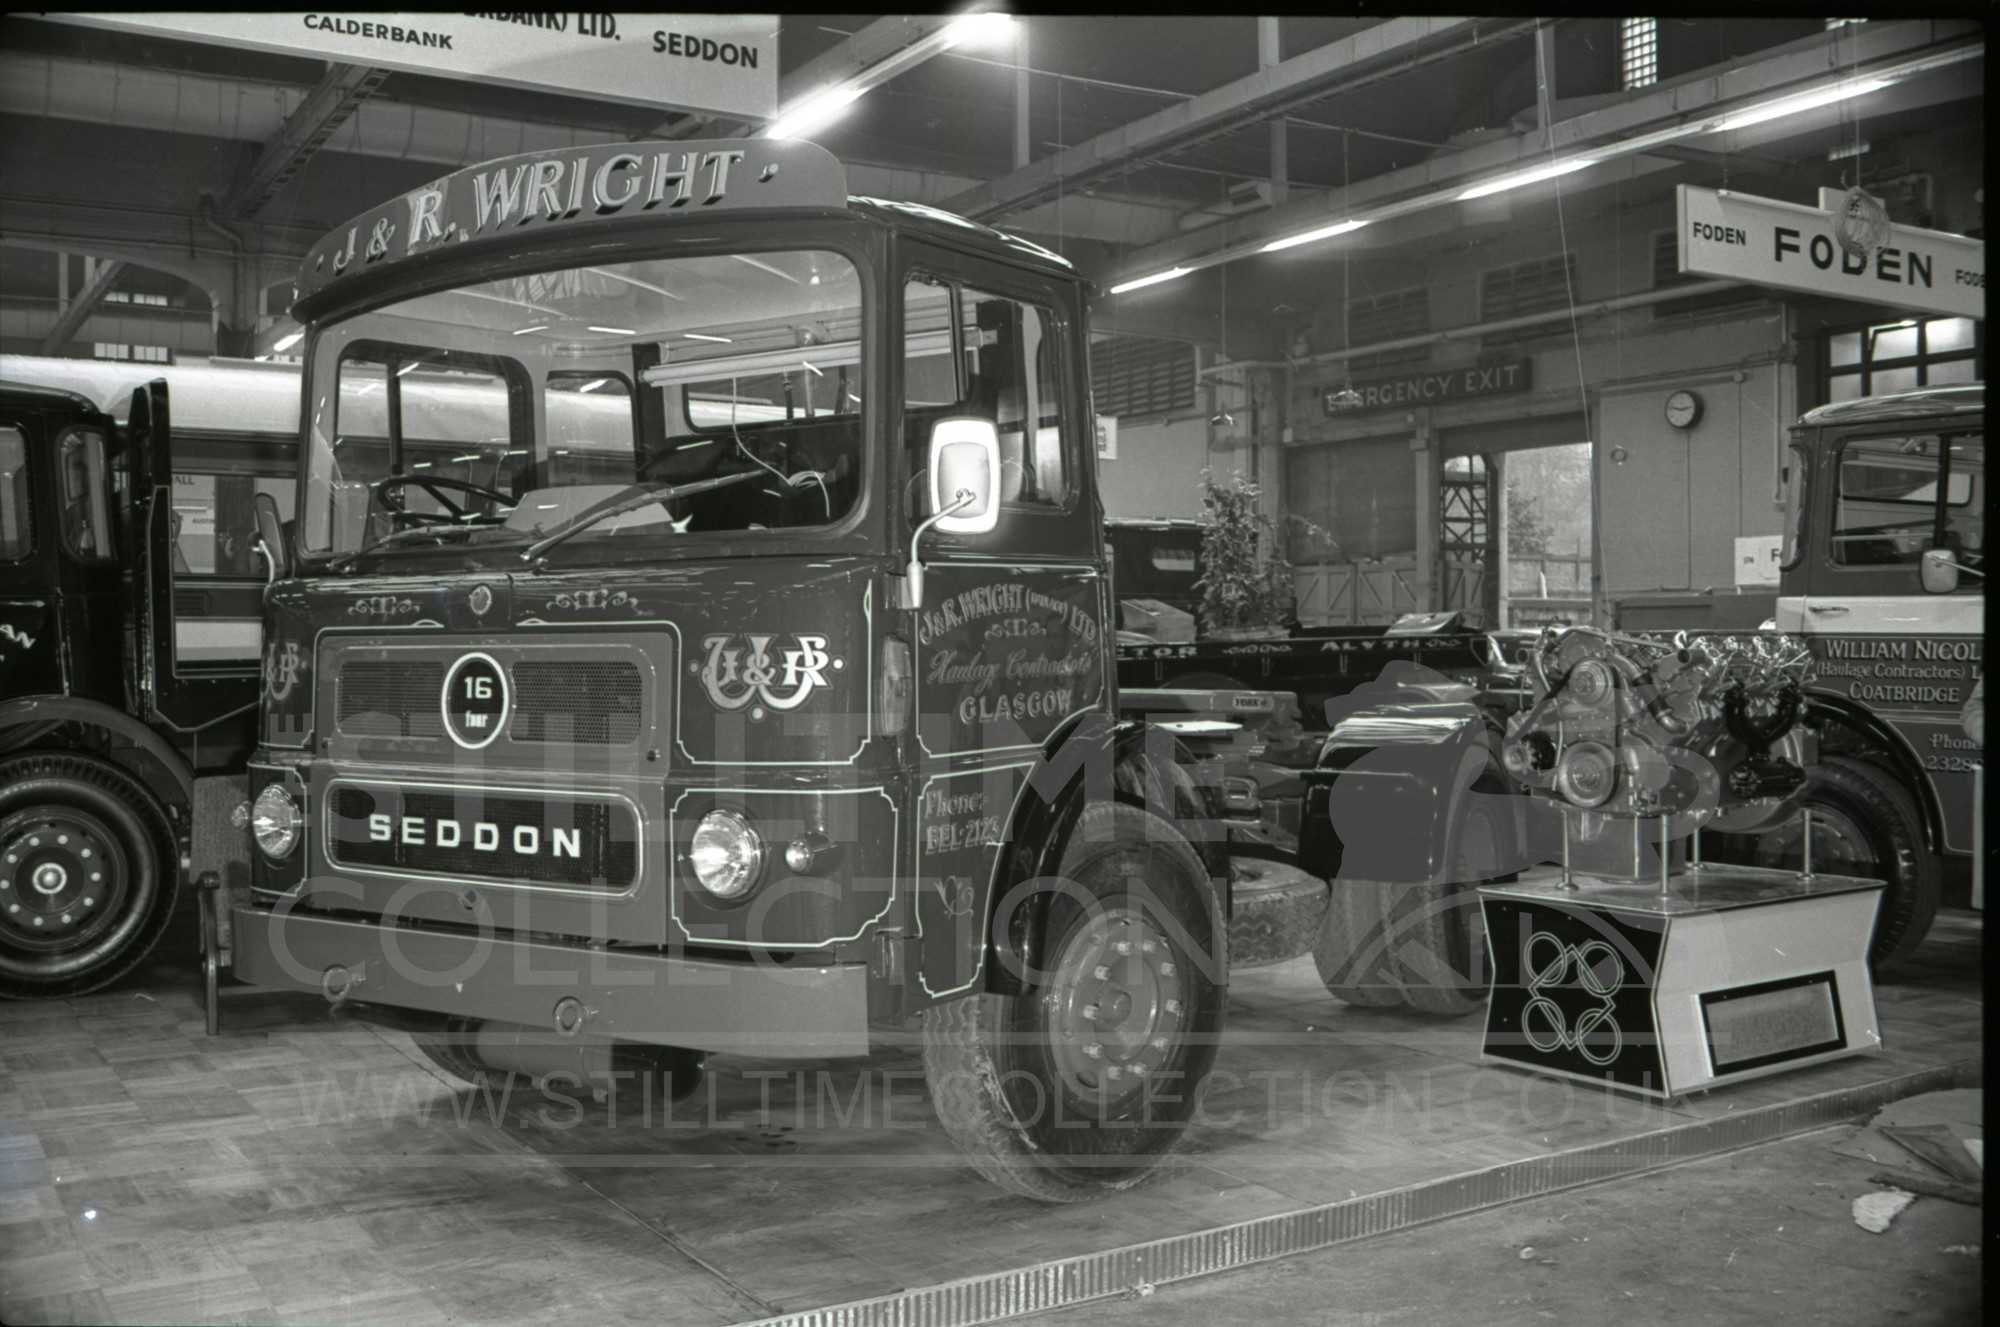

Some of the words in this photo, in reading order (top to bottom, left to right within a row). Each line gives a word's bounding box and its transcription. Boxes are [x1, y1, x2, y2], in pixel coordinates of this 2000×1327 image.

[303, 14, 453, 50] CALDERBANK
[652, 30, 758, 69] SEDDON
[365, 216, 397, 263] &
[472, 149, 745, 231] WRIGHT
[1692, 221, 1747, 246] FODEN
[1774, 226, 1932, 288] FODEN
[1465, 365, 1520, 393] EXIT
[1825, 639, 1906, 660] WILLIAM
[1914, 640, 1981, 661] NICOL
[463, 676, 494, 700] 16
[960, 688, 1073, 724] GLASGOW
[1850, 681, 1960, 703] COATBRIDGE
[369, 813, 581, 858] SEDDON
